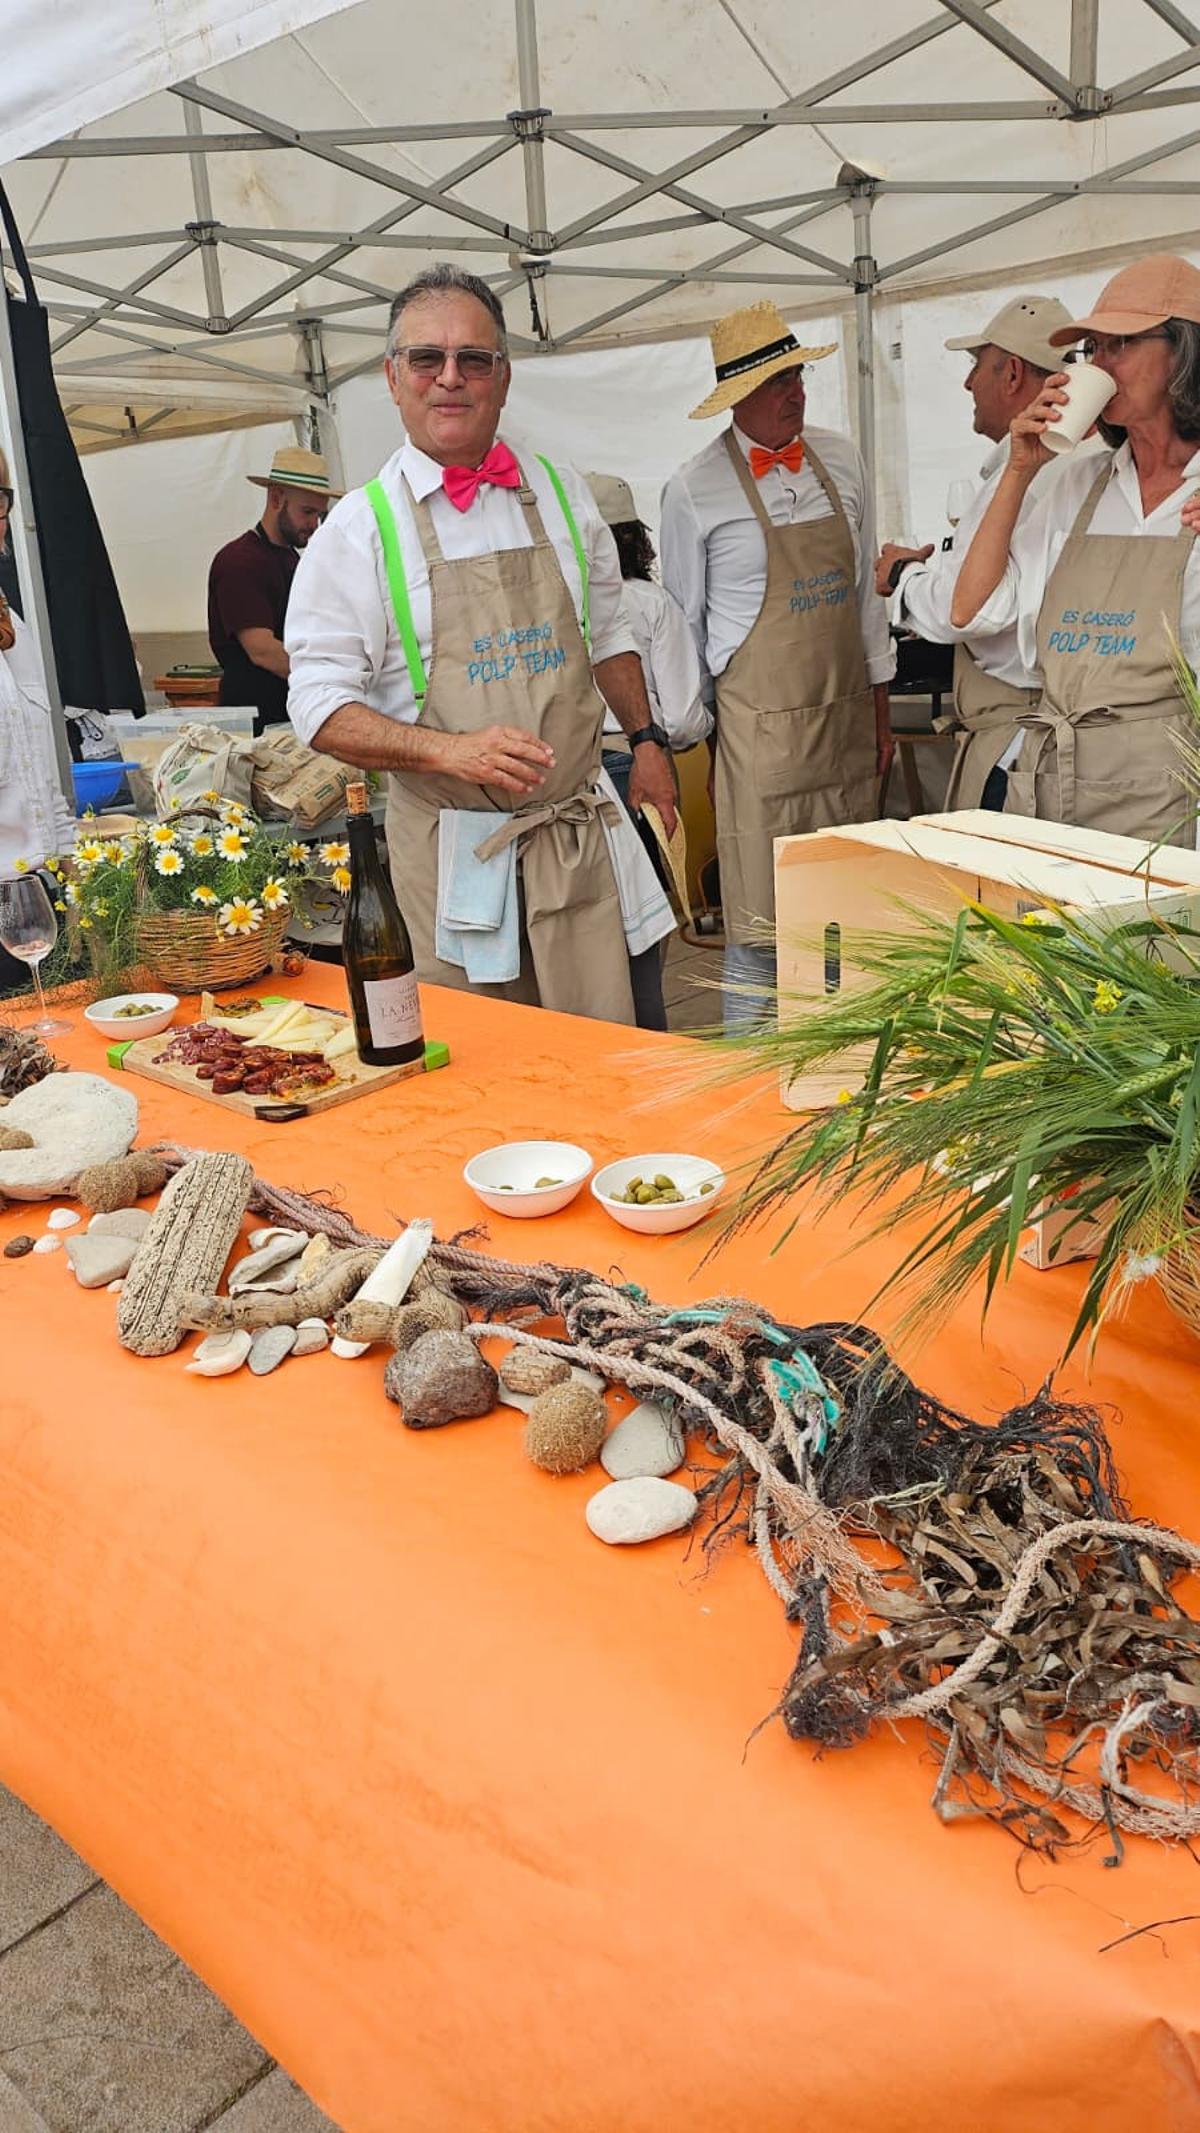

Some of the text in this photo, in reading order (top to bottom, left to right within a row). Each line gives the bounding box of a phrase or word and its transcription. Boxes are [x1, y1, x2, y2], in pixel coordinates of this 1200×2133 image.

[789, 592, 819, 612] POLP
[1062, 609, 1136, 628] ES CASERÓ
[473, 621, 553, 653] ES CASERÓ
[1047, 631, 1137, 656] POLP TEAM
[467, 647, 567, 685] POLP TEAM
